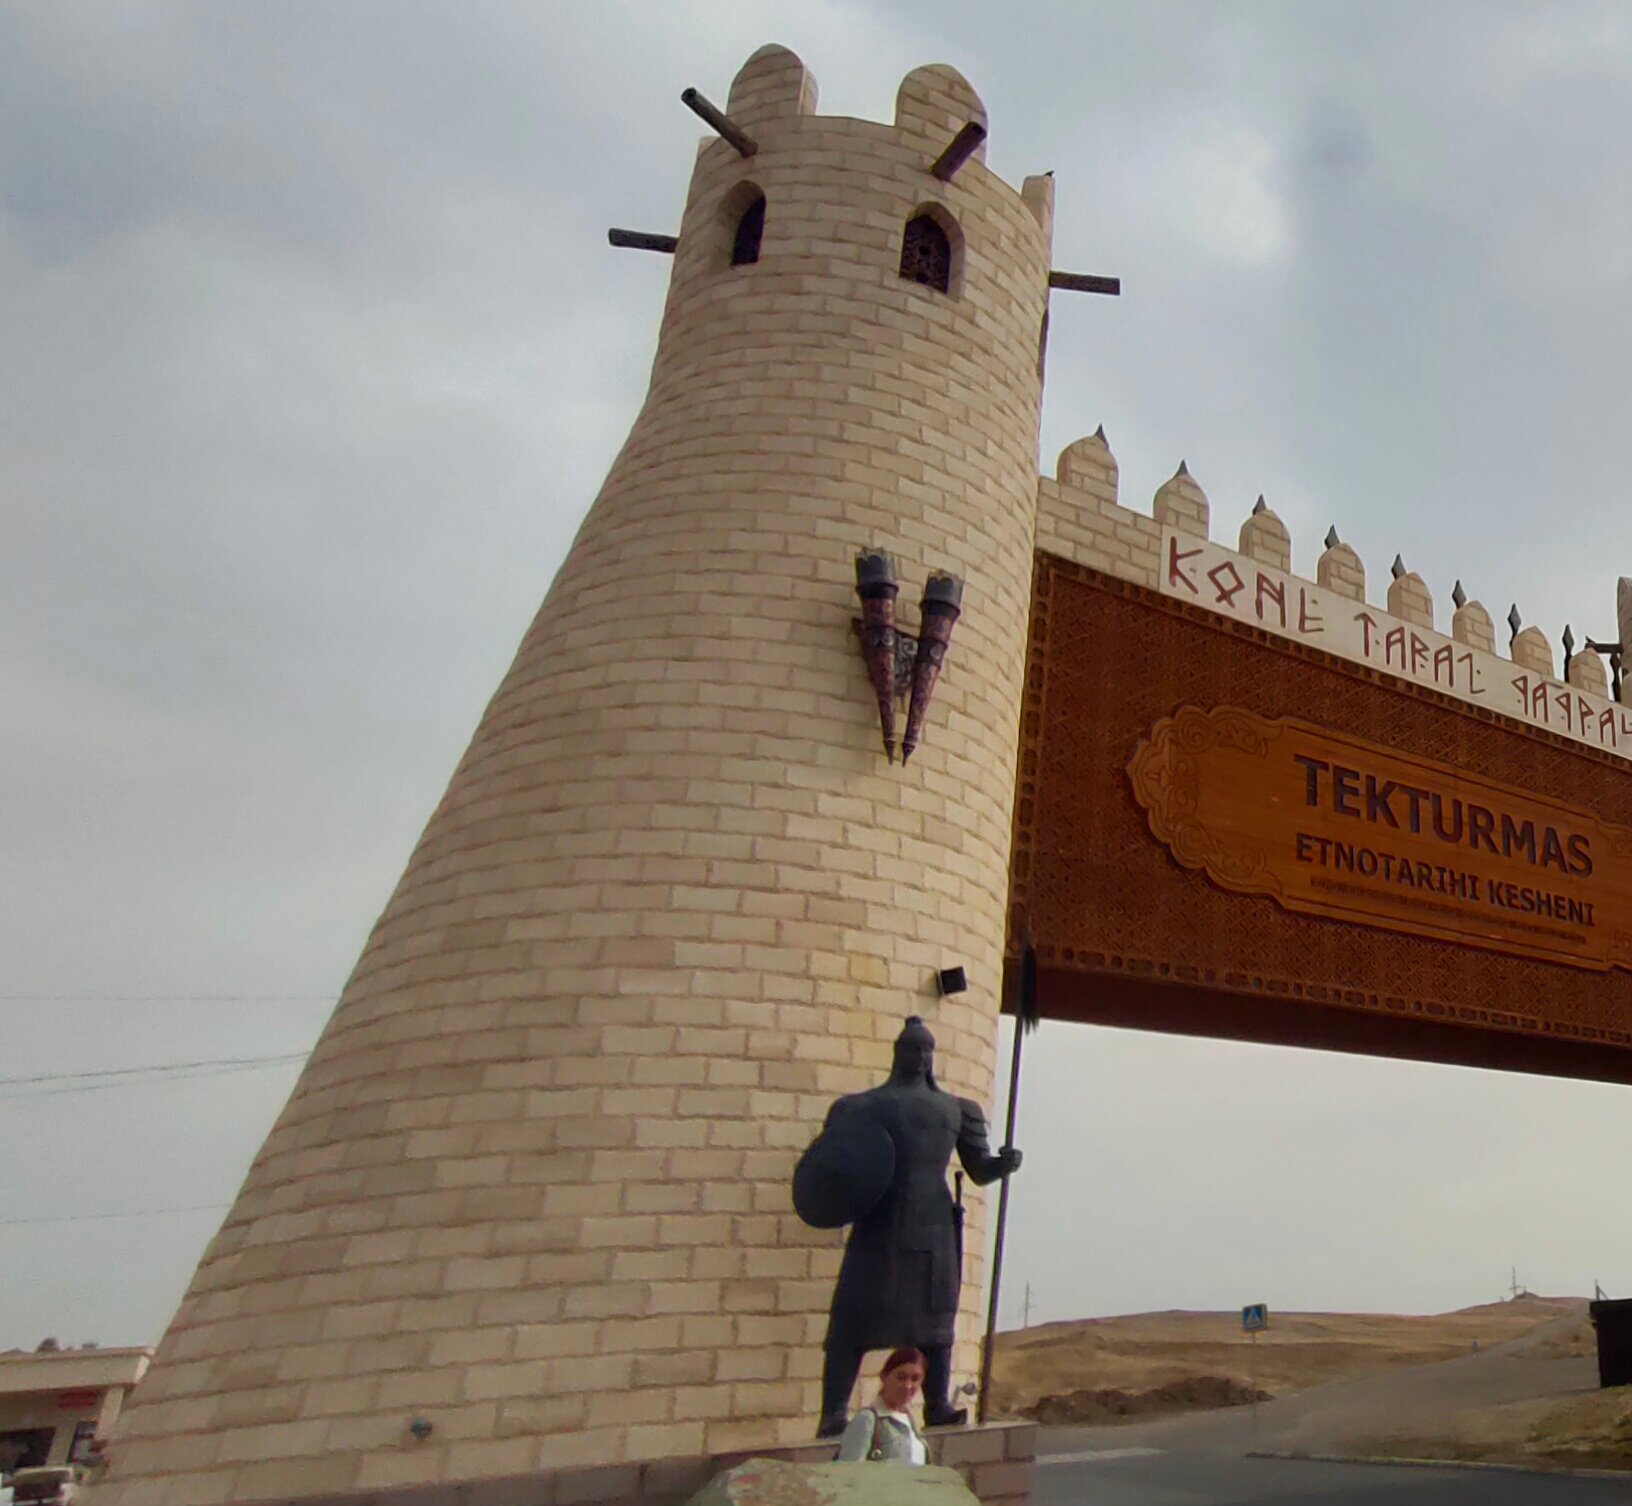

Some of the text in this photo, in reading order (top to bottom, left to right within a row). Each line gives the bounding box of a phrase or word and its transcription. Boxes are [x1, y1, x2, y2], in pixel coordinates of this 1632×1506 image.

[1353, 612, 1485, 695] TARAZ
[1294, 753, 1593, 878] TEKTURMAS
[1296, 832, 1595, 927] ETNOTARIHI KESHENI
